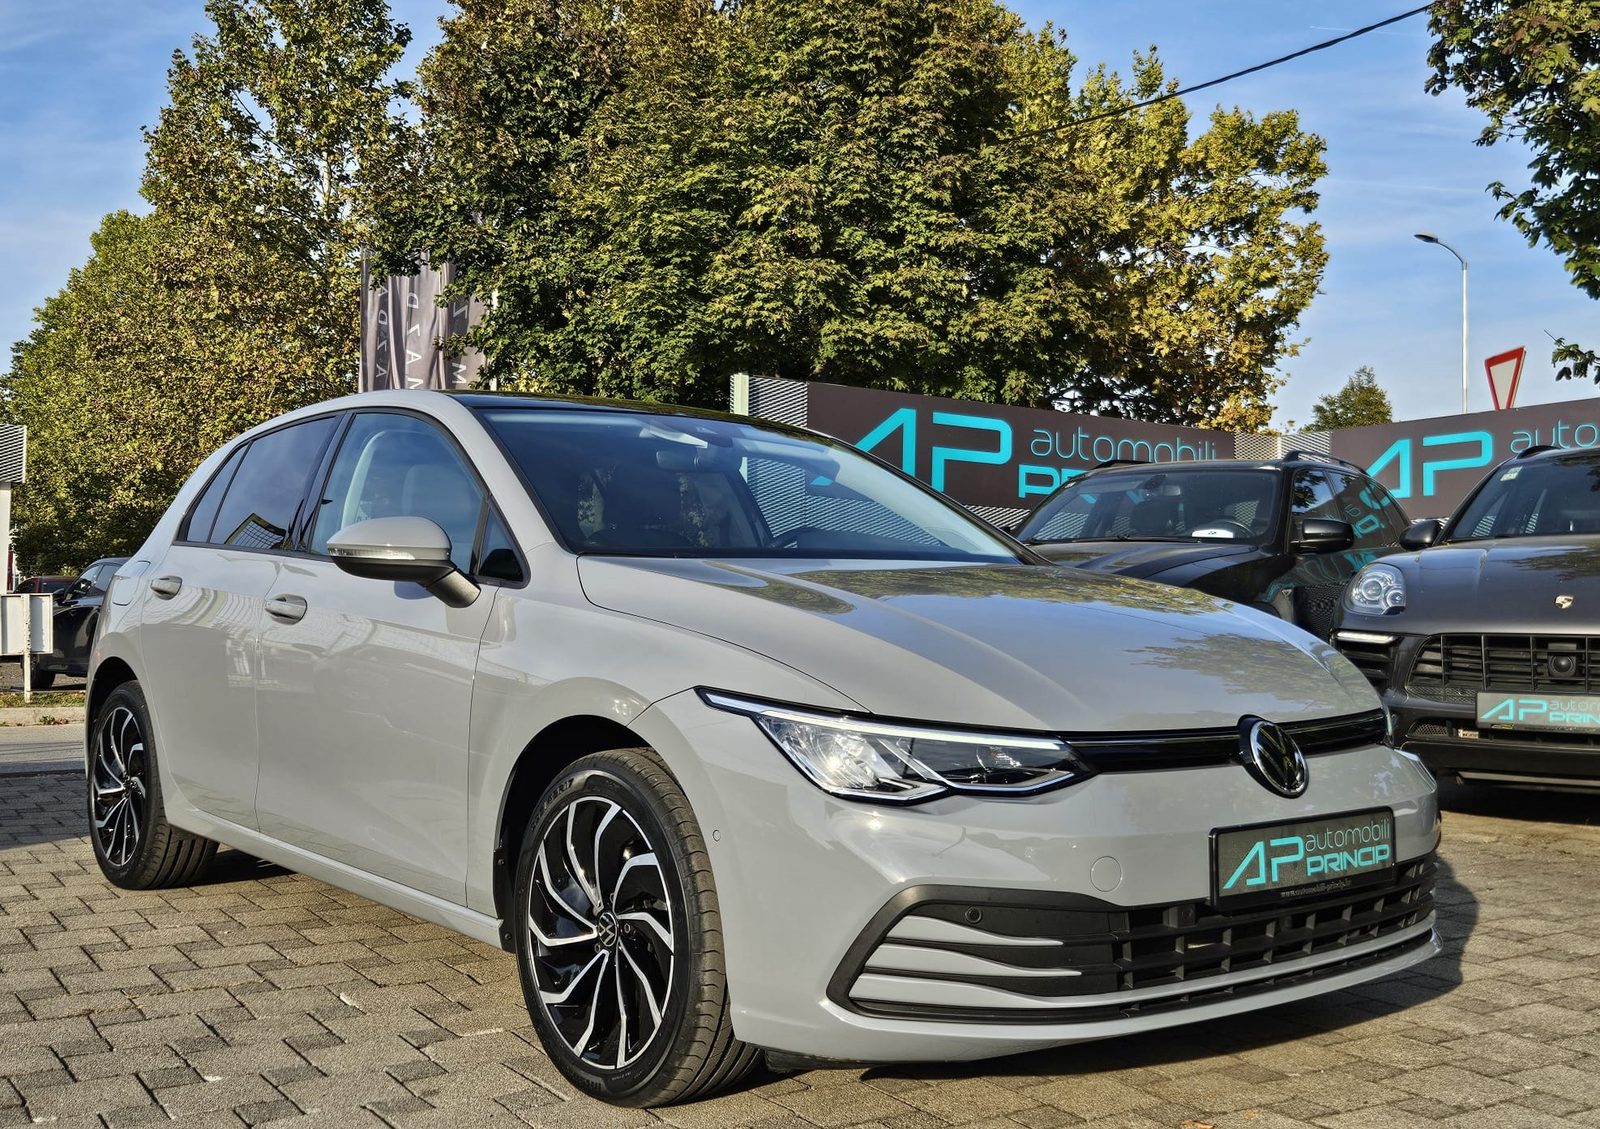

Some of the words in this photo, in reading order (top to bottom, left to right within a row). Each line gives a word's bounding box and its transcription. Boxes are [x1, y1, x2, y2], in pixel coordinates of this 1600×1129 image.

[1480, 698, 1547, 720] AP
[1305, 819, 1390, 852] automobili
[1223, 836, 1305, 889] AP
[1306, 844, 1391, 876] PRINCIP
